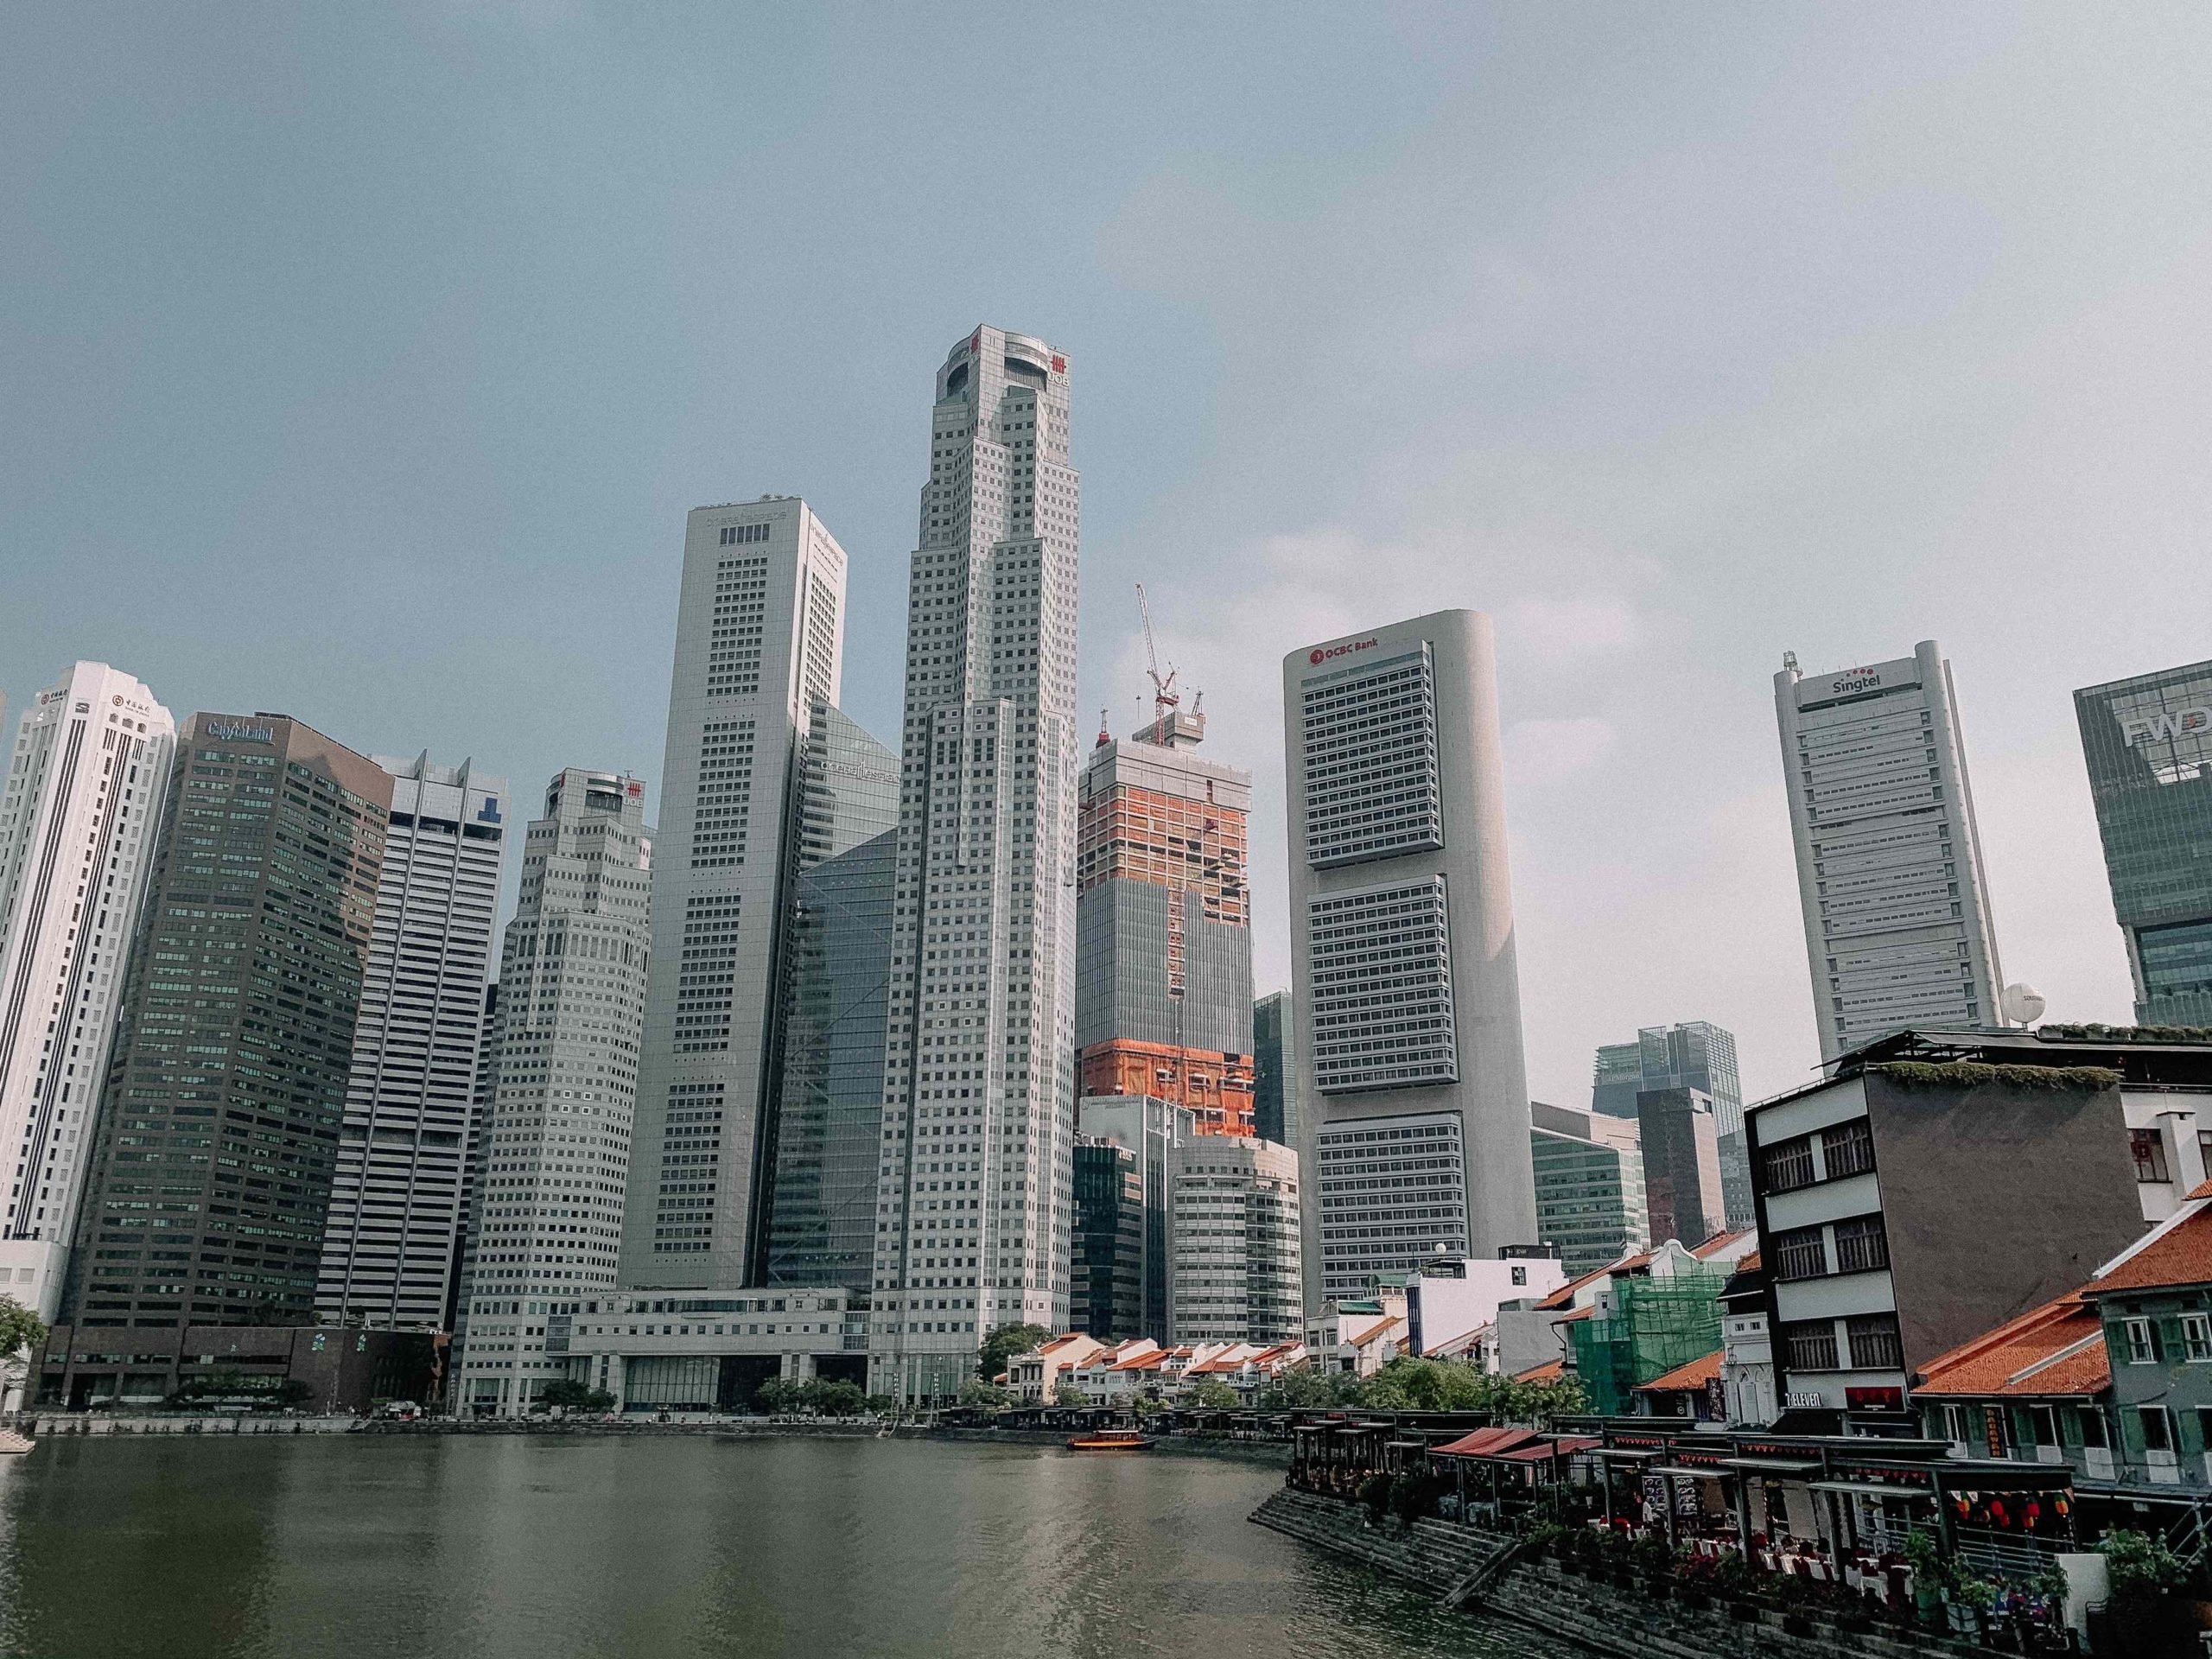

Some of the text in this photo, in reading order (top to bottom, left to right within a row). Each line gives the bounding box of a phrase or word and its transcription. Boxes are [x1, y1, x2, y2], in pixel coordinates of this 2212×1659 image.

[1325, 638, 1378, 658] OCBC Bank
[1833, 675, 1880, 693] Singtel
[208, 721, 274, 741] CapitaLand
[2121, 707, 2212, 747] FWD
